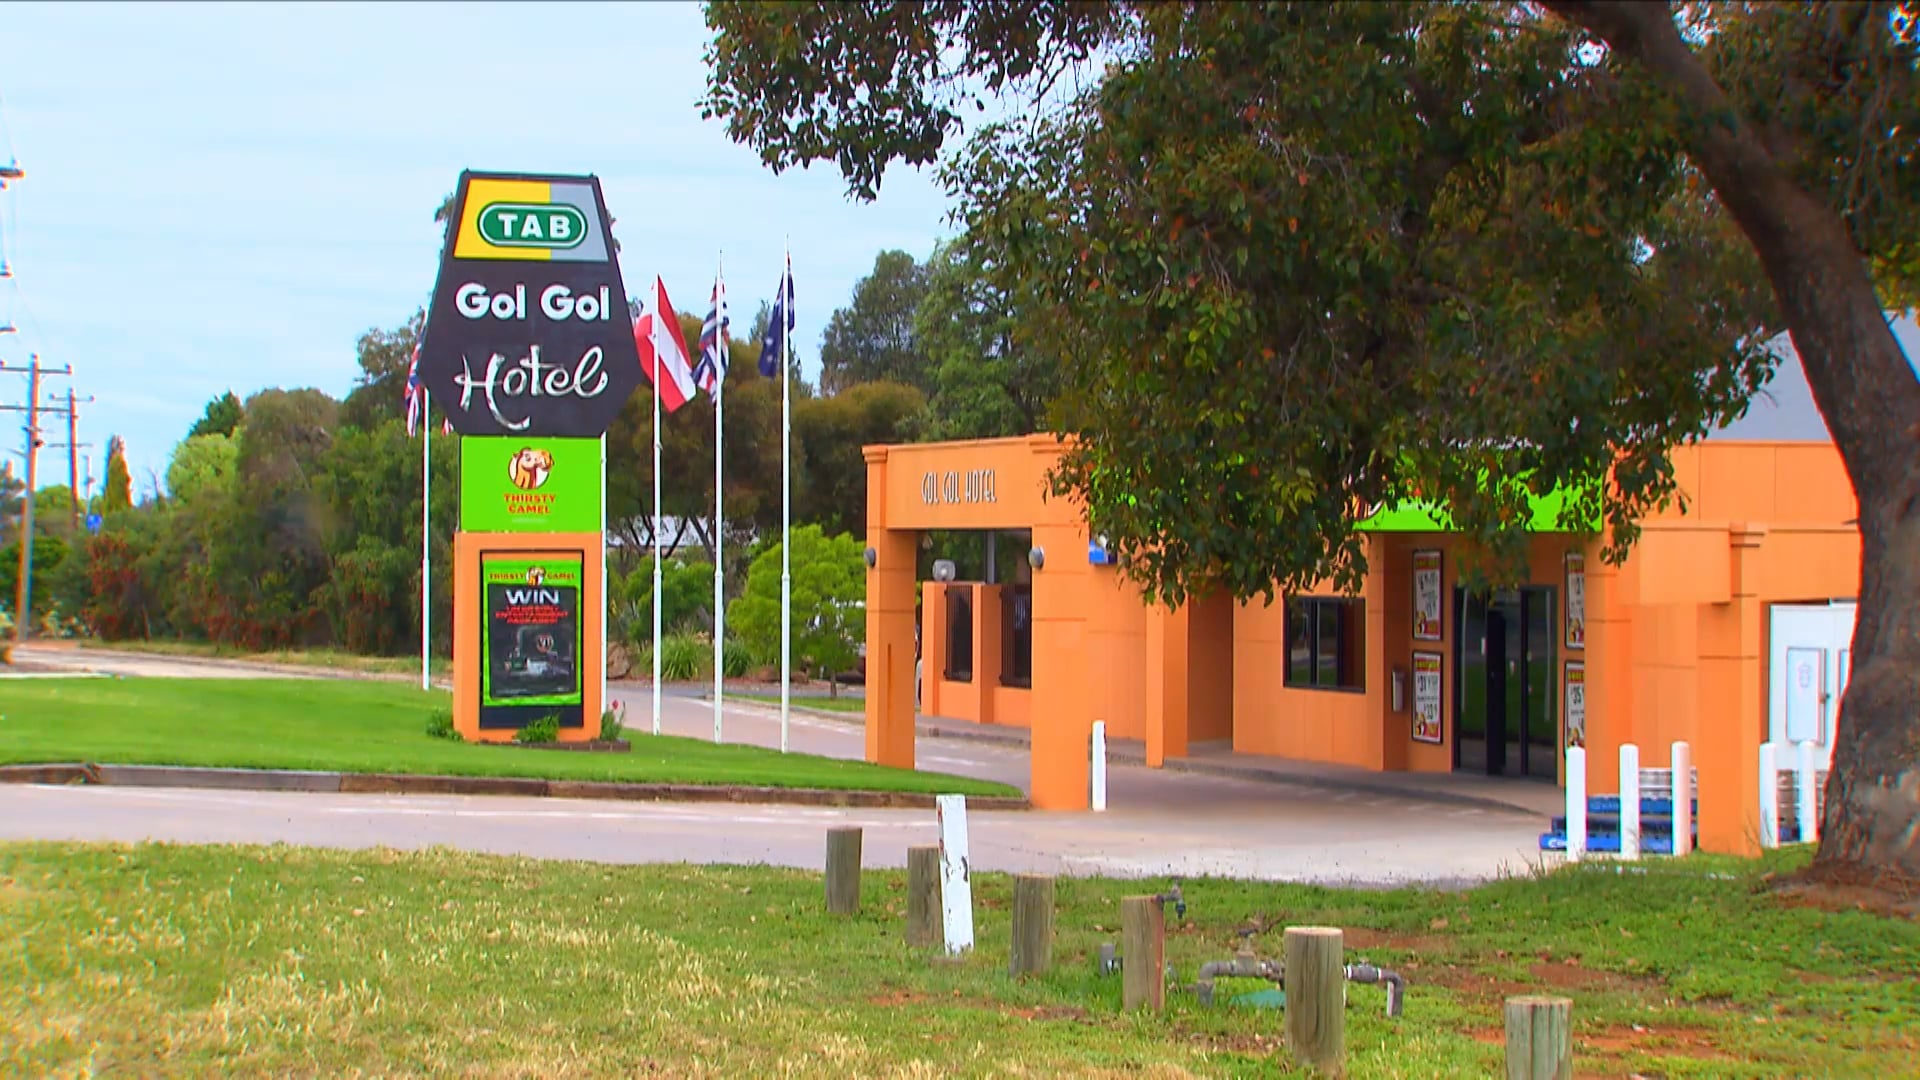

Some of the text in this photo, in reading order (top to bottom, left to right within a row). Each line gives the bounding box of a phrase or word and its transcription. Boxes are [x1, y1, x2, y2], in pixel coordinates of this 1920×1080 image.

[498, 213, 571, 238] TAB
[455, 282, 610, 321] Gol Gol
[453, 344, 609, 431] Hotel
[504, 493, 556, 503] THIRSTY
[921, 469, 998, 505] GOL GOL HOTEL
[508, 504, 550, 514] CAMEL
[505, 589, 559, 604] WIN
